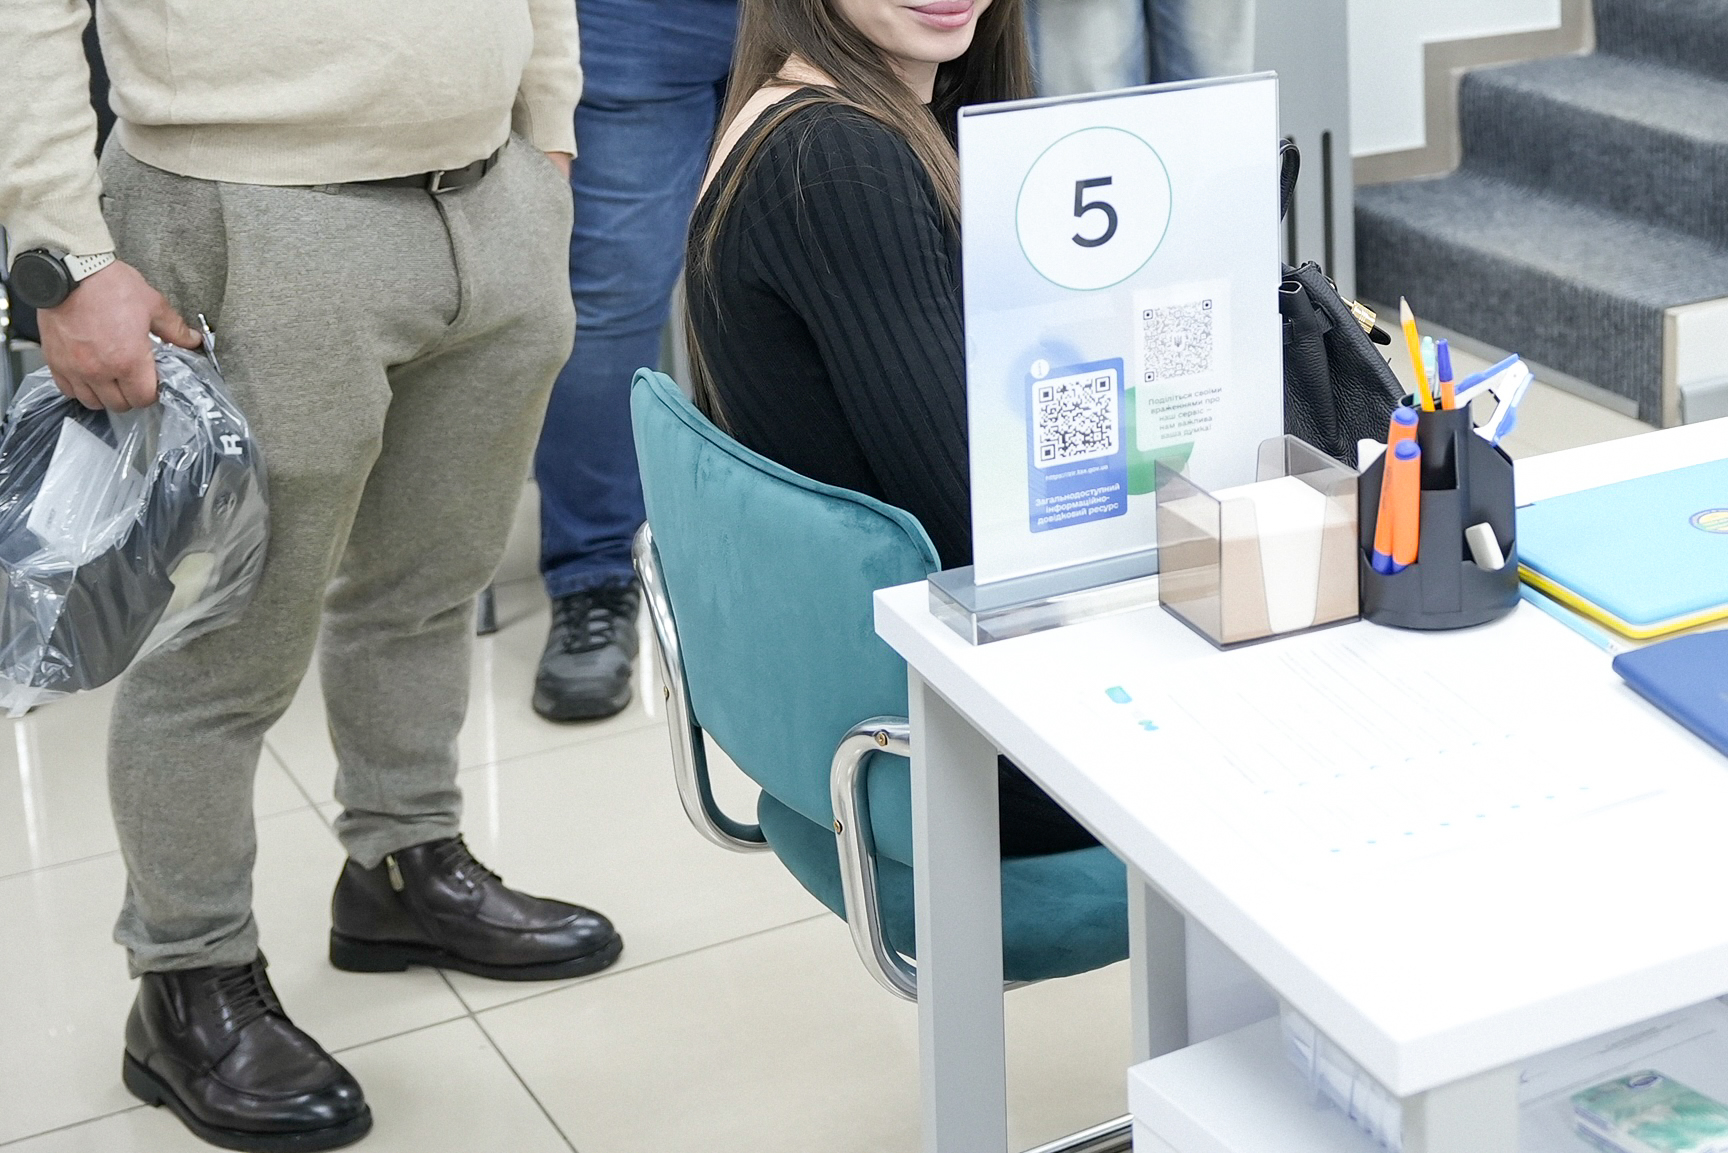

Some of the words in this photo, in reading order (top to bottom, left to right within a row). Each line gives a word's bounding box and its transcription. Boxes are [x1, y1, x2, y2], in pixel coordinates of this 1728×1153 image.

[1071, 175, 1119, 248] 5
[1148, 392, 1193, 406] Поділіться
[1194, 387, 1222, 397] своїми
[1151, 399, 1203, 414] враженнями
[1205, 396, 1220, 405] про
[1178, 408, 1204, 418] сервіс
[1159, 423, 1175, 431] нам
[1177, 416, 1213, 428] важлива
[1183, 424, 1212, 436] думка!
[1035, 482, 1121, 507] Загальнодоступний
[1045, 495, 1110, 513] інформаційно-
[1037, 507, 1087, 526] довідковий
[1088, 502, 1120, 516] ресурс
